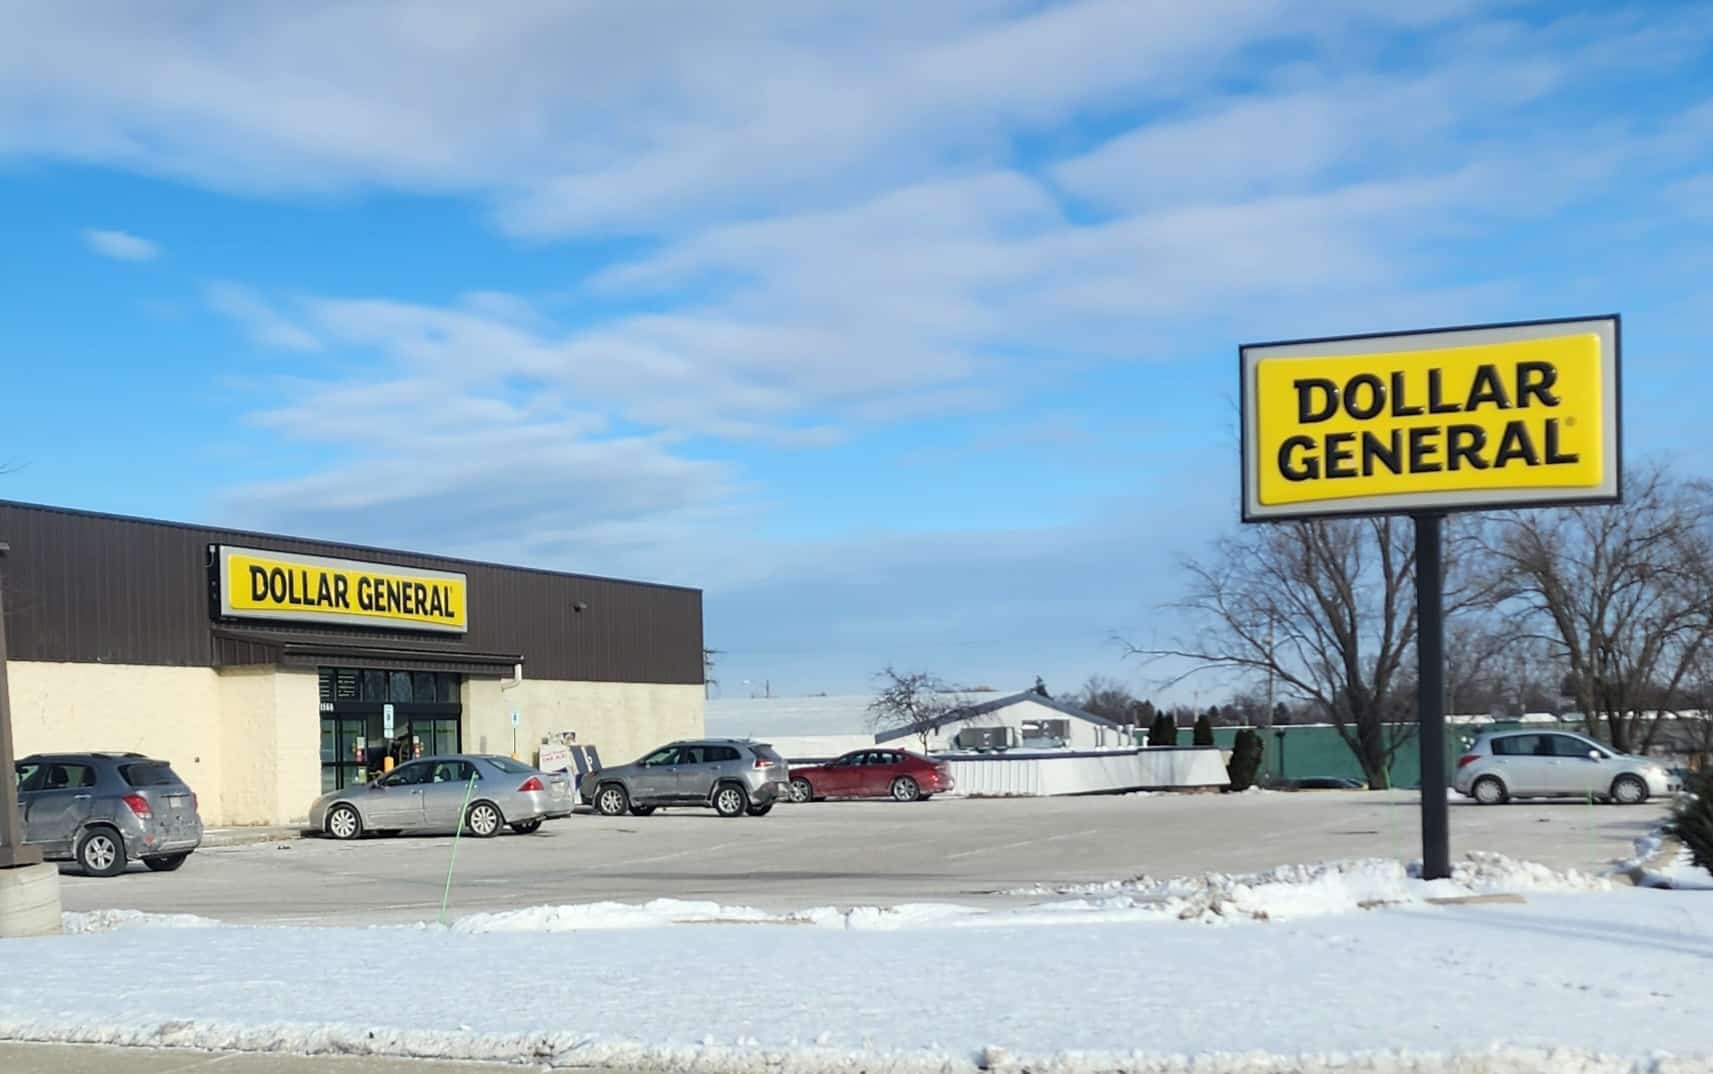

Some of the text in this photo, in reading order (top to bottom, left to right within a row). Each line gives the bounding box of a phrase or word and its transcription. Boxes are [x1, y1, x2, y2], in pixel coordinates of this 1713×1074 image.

[1293, 361, 1560, 424] DOLLAR
[1277, 418, 1580, 482] GENERAL
[249, 565, 455, 618] DOLLAR GENERAL
